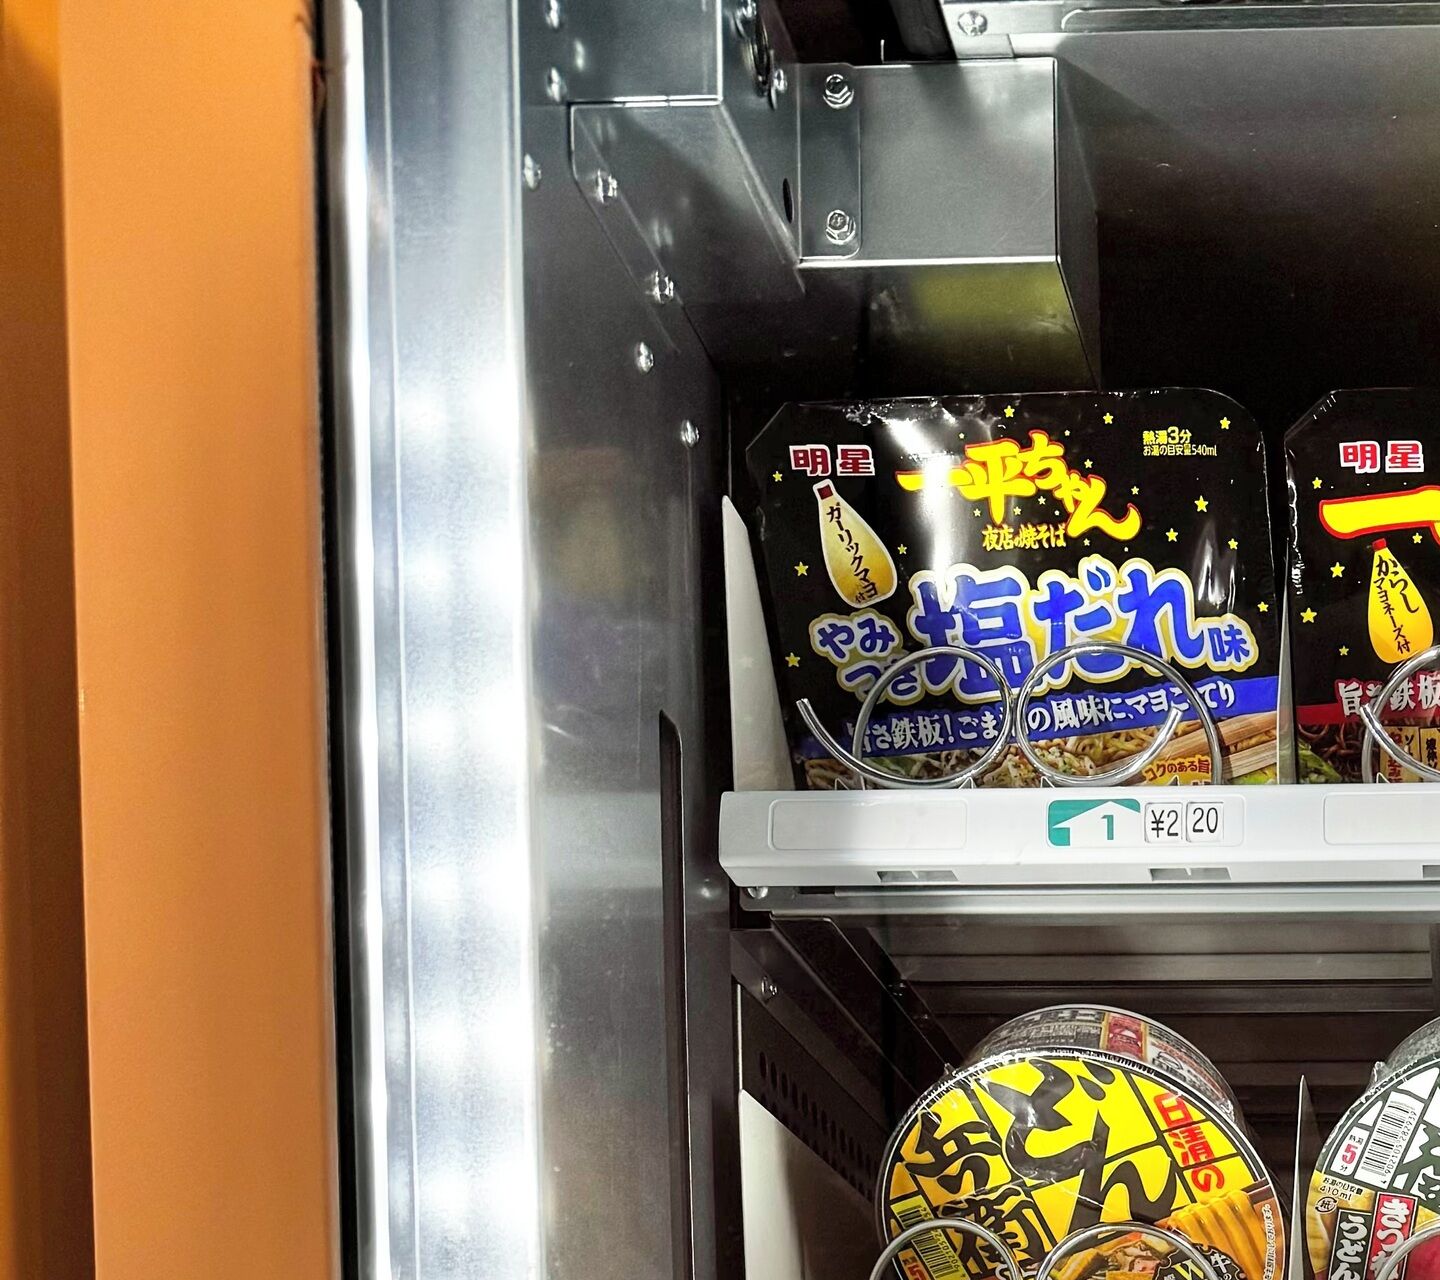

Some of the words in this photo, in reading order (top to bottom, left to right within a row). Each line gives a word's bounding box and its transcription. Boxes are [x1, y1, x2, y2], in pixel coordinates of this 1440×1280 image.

[1142, 426, 1192, 444] 熱湯3分
[1340, 440, 1424, 474] 明星
[790, 444, 875, 476] 明星
[896, 428, 1143, 541] 一平ちゃん
[982, 524, 1067, 551] 夜店の焼そば
[1375, 556, 1420, 615] からし
[912, 557, 1254, 700] 塩だれ味
[1375, 577, 1412, 655] マヨネーズ付
[1102, 814, 1116, 841] 1
[1154, 1091, 1227, 1194] 日清の
